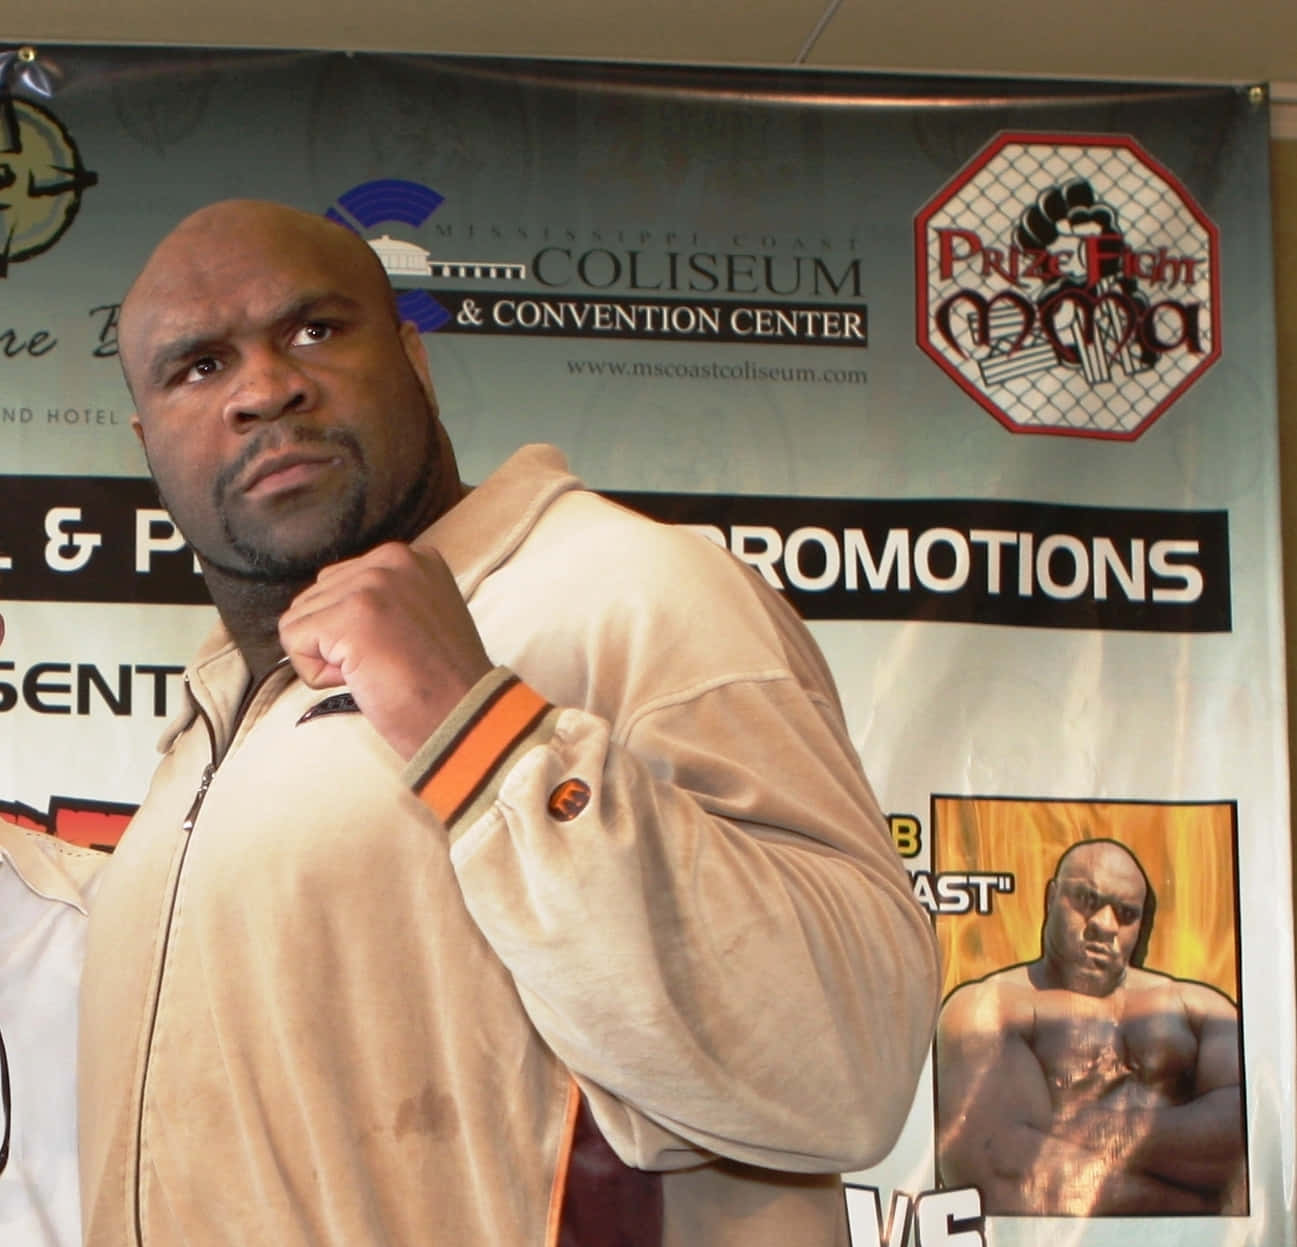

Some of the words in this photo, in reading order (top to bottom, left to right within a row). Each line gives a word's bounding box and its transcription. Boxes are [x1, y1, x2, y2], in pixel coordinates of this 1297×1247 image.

[531, 246, 865, 298] COLISEUM
[89, 303, 120, 358] B
[457, 300, 483, 327] &
[492, 301, 720, 335] CONVENTION
[730, 309, 866, 340] CENTER
[566, 357, 868, 385] www.mscoastcoliseum.com
[47, 409, 120, 427] HOTEL
[45, 508, 101, 571] &
[911, 874, 1012, 913] AST"
